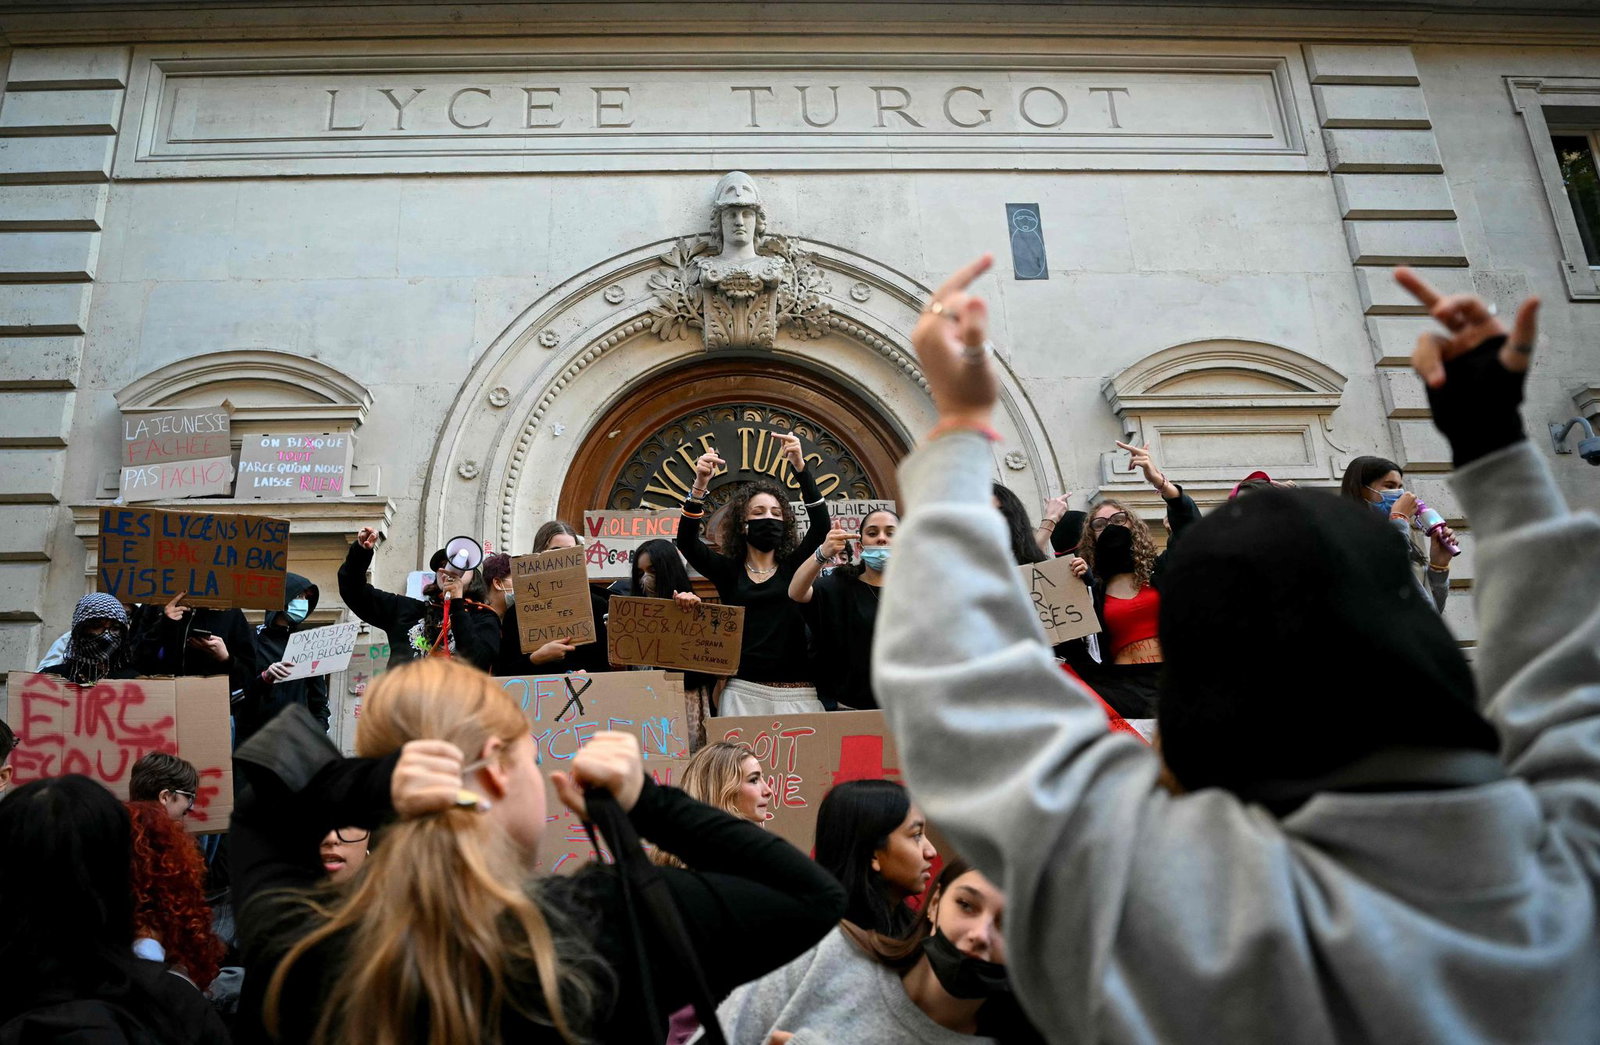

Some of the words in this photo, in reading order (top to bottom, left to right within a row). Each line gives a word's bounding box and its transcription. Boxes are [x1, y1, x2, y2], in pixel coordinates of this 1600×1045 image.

[324, 87, 635, 132] LYCEE
[730, 86, 1130, 129] TURGOT
[260, 438, 280, 448] ON
[275, 450, 314, 462] TOUT
[737, 427, 849, 500] TURGO
[239, 461, 275, 473] PARCE
[314, 463, 344, 474] NOUS
[124, 466, 160, 491] PAS
[253, 476, 294, 488] LAISSE
[299, 474, 344, 492] RIEN
[102, 510, 151, 537] LES
[102, 537, 139, 564] LE
[213, 545, 238, 568] LA
[246, 547, 286, 572] BAC
[517, 553, 584, 575] MARIANNE
[189, 568, 219, 596] LA
[550, 580, 563, 591] TU
[557, 609, 574, 617] TES
[614, 600, 666, 618] VOTEZ
[611, 618, 657, 633] SOSO
[660, 618, 670, 633] &
[674, 619, 708, 638] ALEX
[292, 633, 311, 645] ON
[614, 634, 676, 664] CVL
